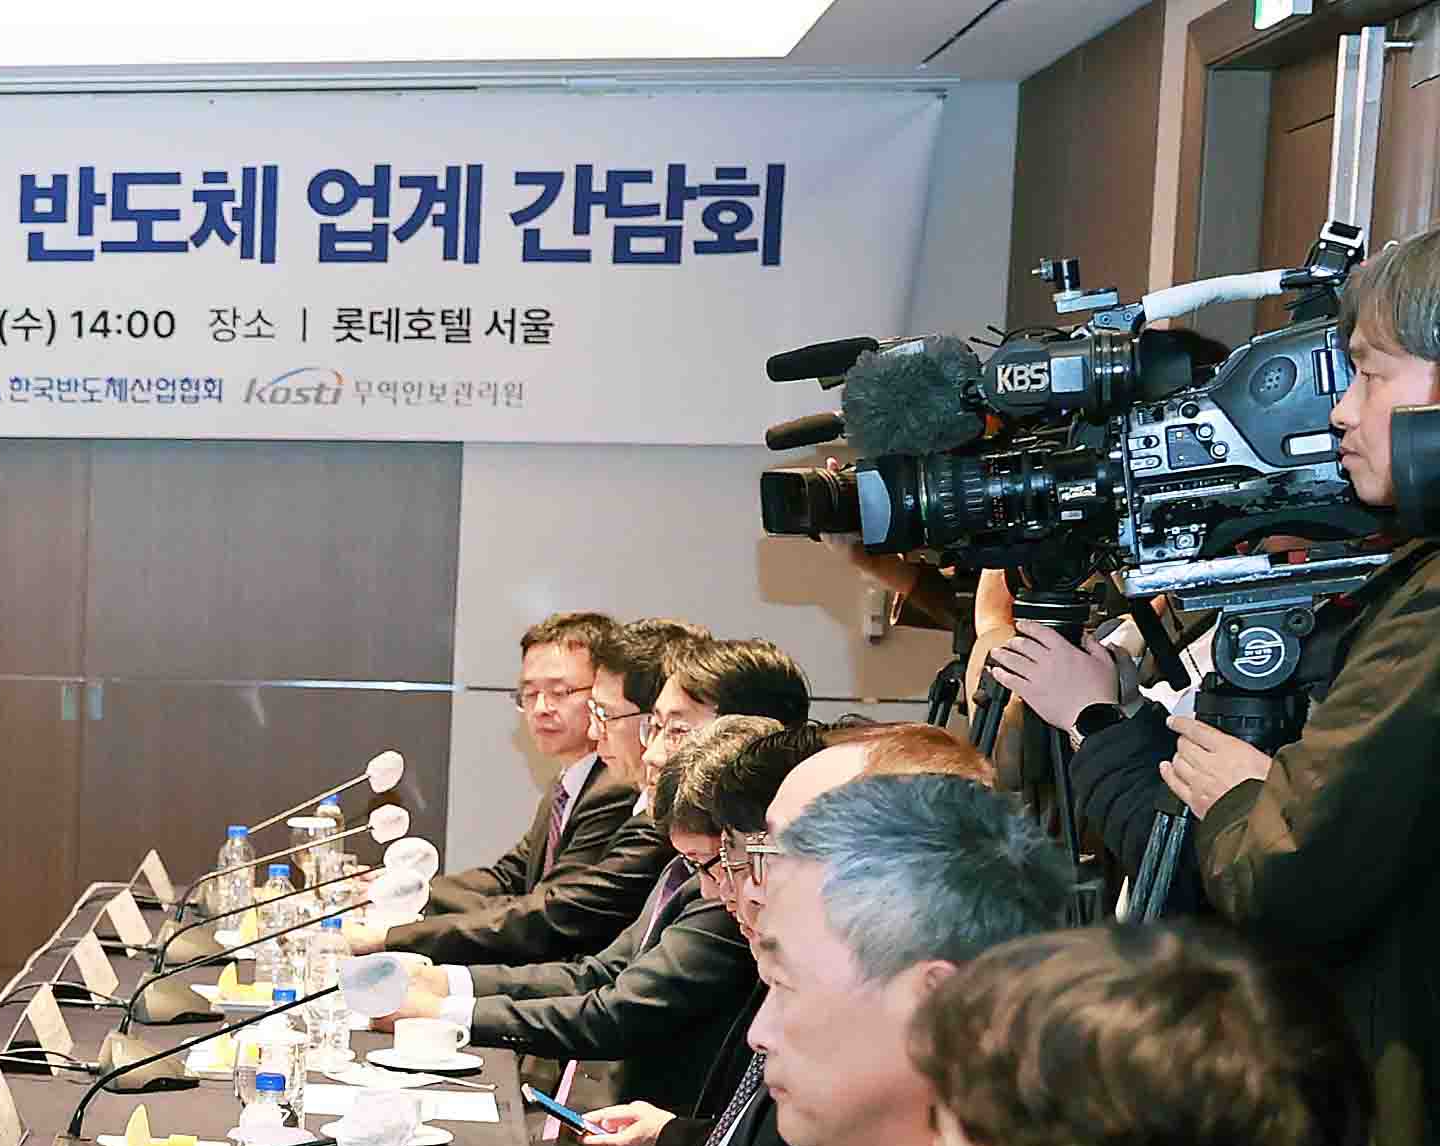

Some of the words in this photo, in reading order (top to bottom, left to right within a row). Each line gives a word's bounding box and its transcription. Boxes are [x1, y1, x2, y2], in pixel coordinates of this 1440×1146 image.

[18, 165, 278, 264] 반도체
[307, 164, 483, 264] 업계
[509, 163, 787, 267] 간담회
[70, 309, 177, 340] 14:00
[208, 306, 276, 343] 장소
[332, 306, 473, 345] 롯데호텔
[484, 307, 555, 345] 서울
[8, 376, 224, 408] 한국반도체산업협회
[996, 361, 1049, 394] KBS
